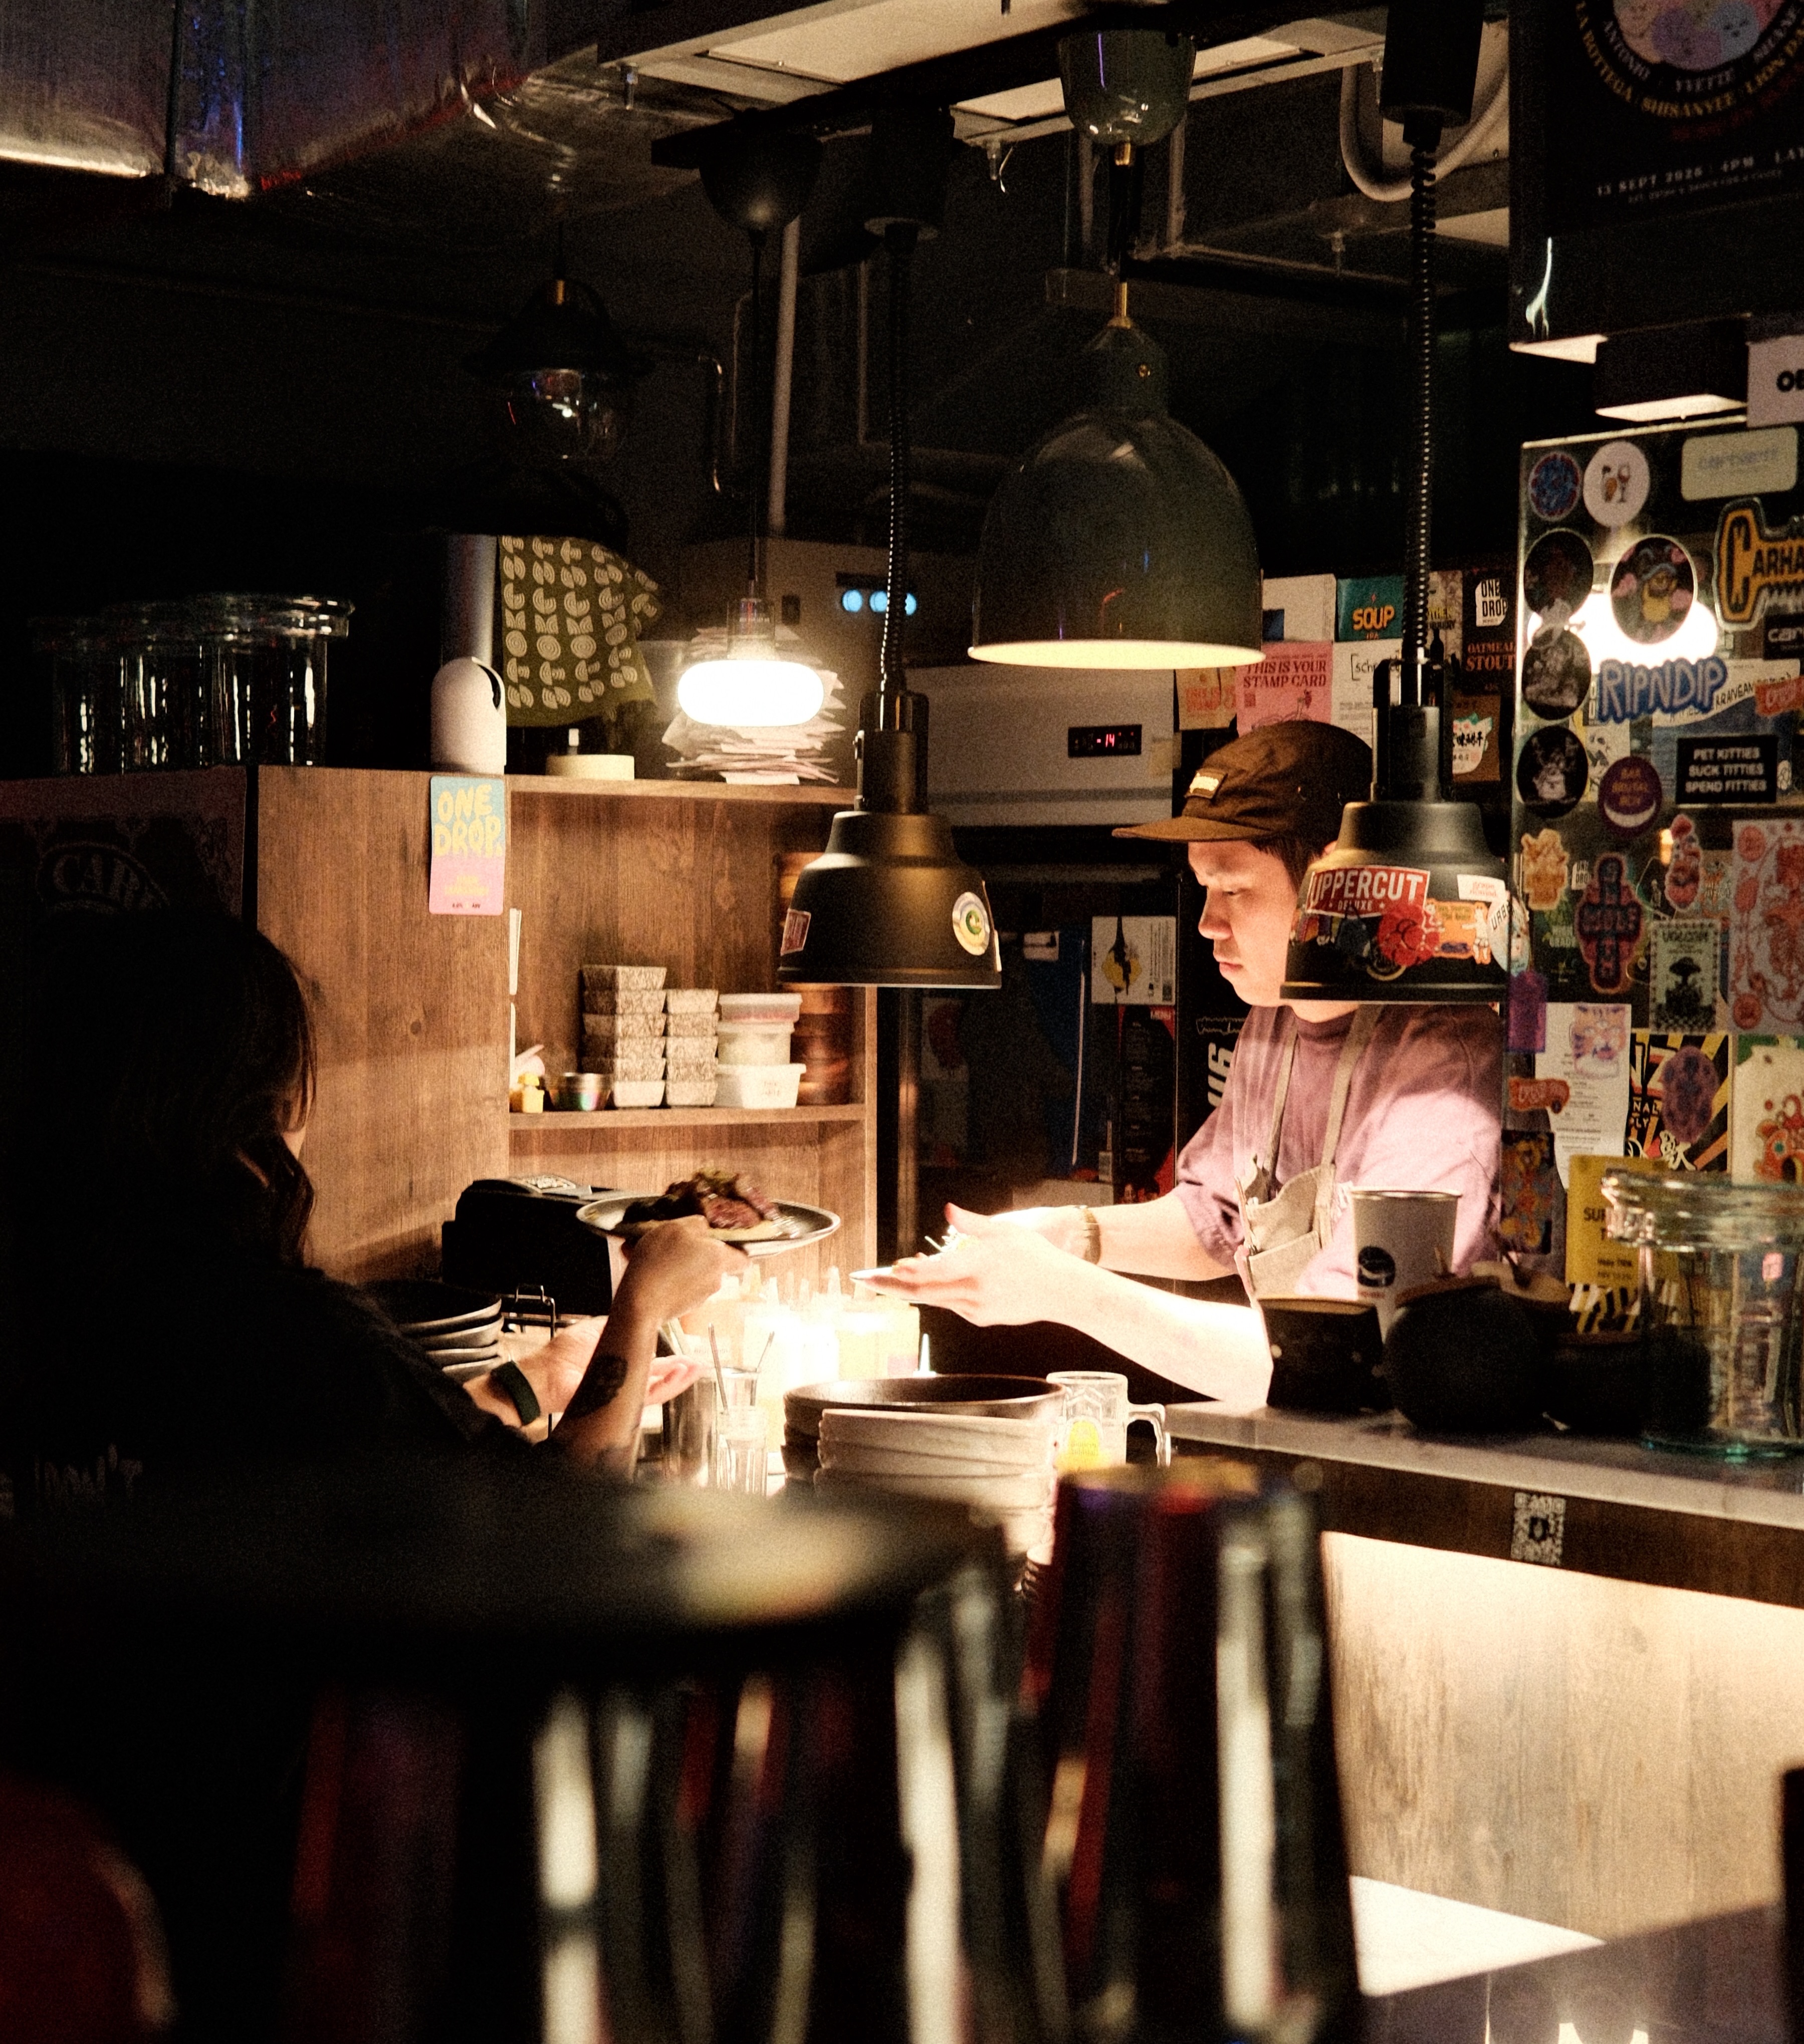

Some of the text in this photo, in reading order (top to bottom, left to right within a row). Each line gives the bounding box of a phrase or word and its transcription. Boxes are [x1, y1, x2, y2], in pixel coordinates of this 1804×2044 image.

[1481, 578, 1500, 597] ONE
[1482, 598, 1507, 617] DROP
[1352, 605, 1395, 630] SOUP
[1246, 660, 1327, 674] THIS IS YOUR
[1466, 654, 1516, 672] STOUT
[1243, 674, 1327, 688] STAMP CARD
[1600, 657, 1727, 721] RIPNDIP
[1693, 746, 1760, 761] PET KITTIES
[1688, 762, 1764, 777] SUCK TITTIES
[1685, 780, 1723, 794] SPEND
[437, 783, 493, 823] ONE
[1309, 870, 1424, 907] UPPERCUT
